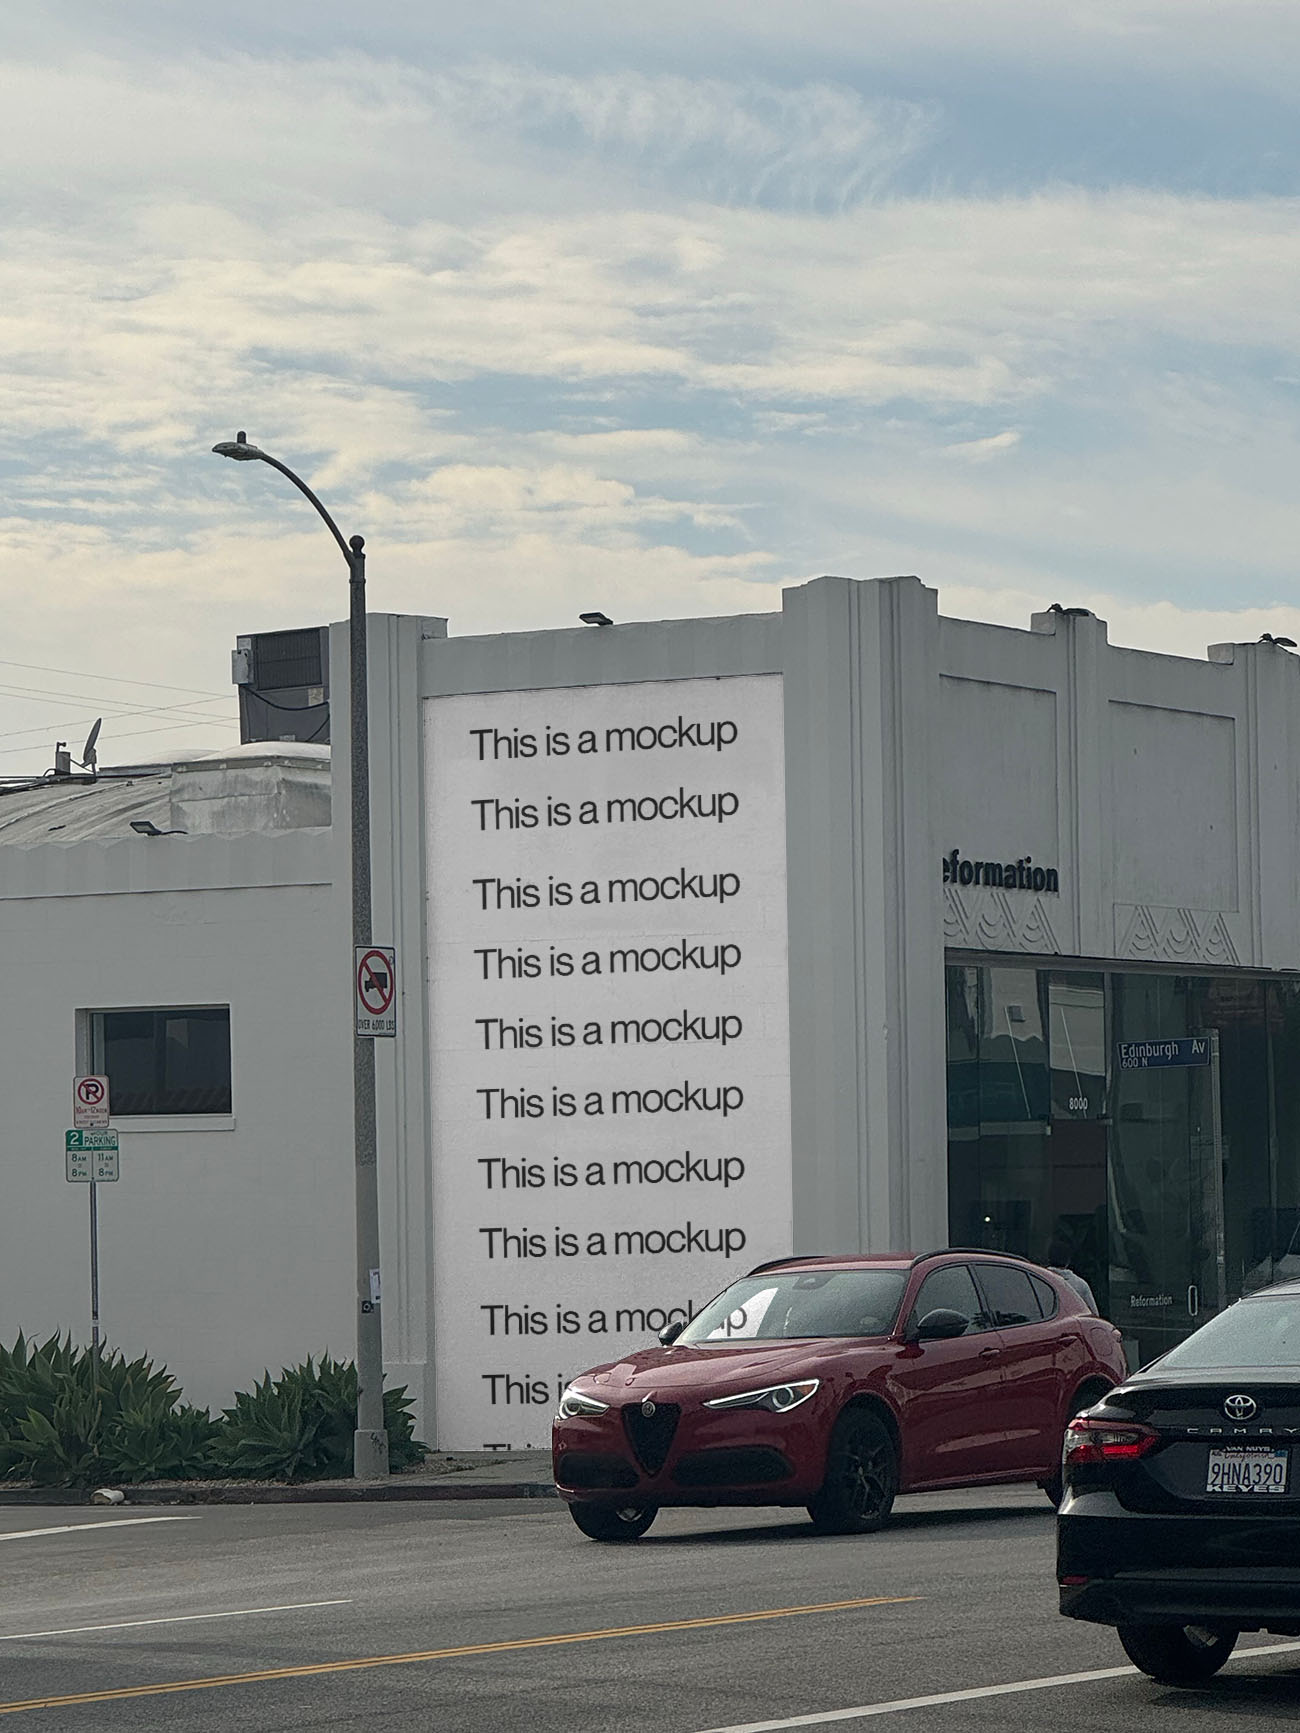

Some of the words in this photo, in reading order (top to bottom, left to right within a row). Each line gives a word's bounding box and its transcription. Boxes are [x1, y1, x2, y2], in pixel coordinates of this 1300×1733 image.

[469, 727, 538, 761] This
[545, 725, 571, 757] is
[577, 730, 599, 755] a
[605, 715, 738, 753] mockup
[470, 797, 540, 831] This
[546, 795, 572, 827] is
[578, 800, 600, 825] a
[606, 786, 740, 824] mockup
[943, 849, 1059, 893] eformation
[472, 877, 541, 911] This
[548, 875, 574, 907] is
[579, 880, 601, 905] a
[608, 867, 741, 904] mockup
[473, 947, 542, 980] This
[549, 945, 575, 977] is
[581, 951, 603, 976] a
[609, 938, 742, 976] mockup
[358, 1019, 370, 1030] OVER
[474, 1017, 543, 1050] This
[551, 1016, 576, 1047] is
[582, 1021, 604, 1046] a
[610, 1008, 743, 1046] mockup
[1121, 1042, 1179, 1060] Edinburgh
[1191, 1040, 1206, 1054] Av
[1121, 1058, 1139, 1068] 600
[1141, 1057, 1149, 1067] N
[475, 1087, 545, 1120] This
[552, 1085, 577, 1117] is
[583, 1091, 605, 1116] a
[611, 1079, 744, 1118] mockup
[1069, 1097, 1088, 1110] 8000
[70, 1131, 80, 1145] 2
[84, 1136, 116, 1146] PARKING
[477, 1157, 546, 1190] This
[553, 1156, 579, 1187] is
[584, 1161, 606, 1186] a
[613, 1150, 746, 1189] mockup
[478, 1227, 547, 1259] This
[554, 1226, 580, 1257] is
[585, 1232, 608, 1256] a
[614, 1220, 747, 1259] mockup
[479, 1303, 549, 1336] This
[555, 1303, 581, 1335] is
[587, 1309, 609, 1334] a
[615, 1299, 748, 1337] mocp
[1130, 1294, 1173, 1308] Reformation
[480, 1373, 550, 1405] This
[556, 1372, 572, 1404] i
[1206, 1484, 1285, 1493] KEYES
[1211, 1462, 1283, 1485] 9HNA390
